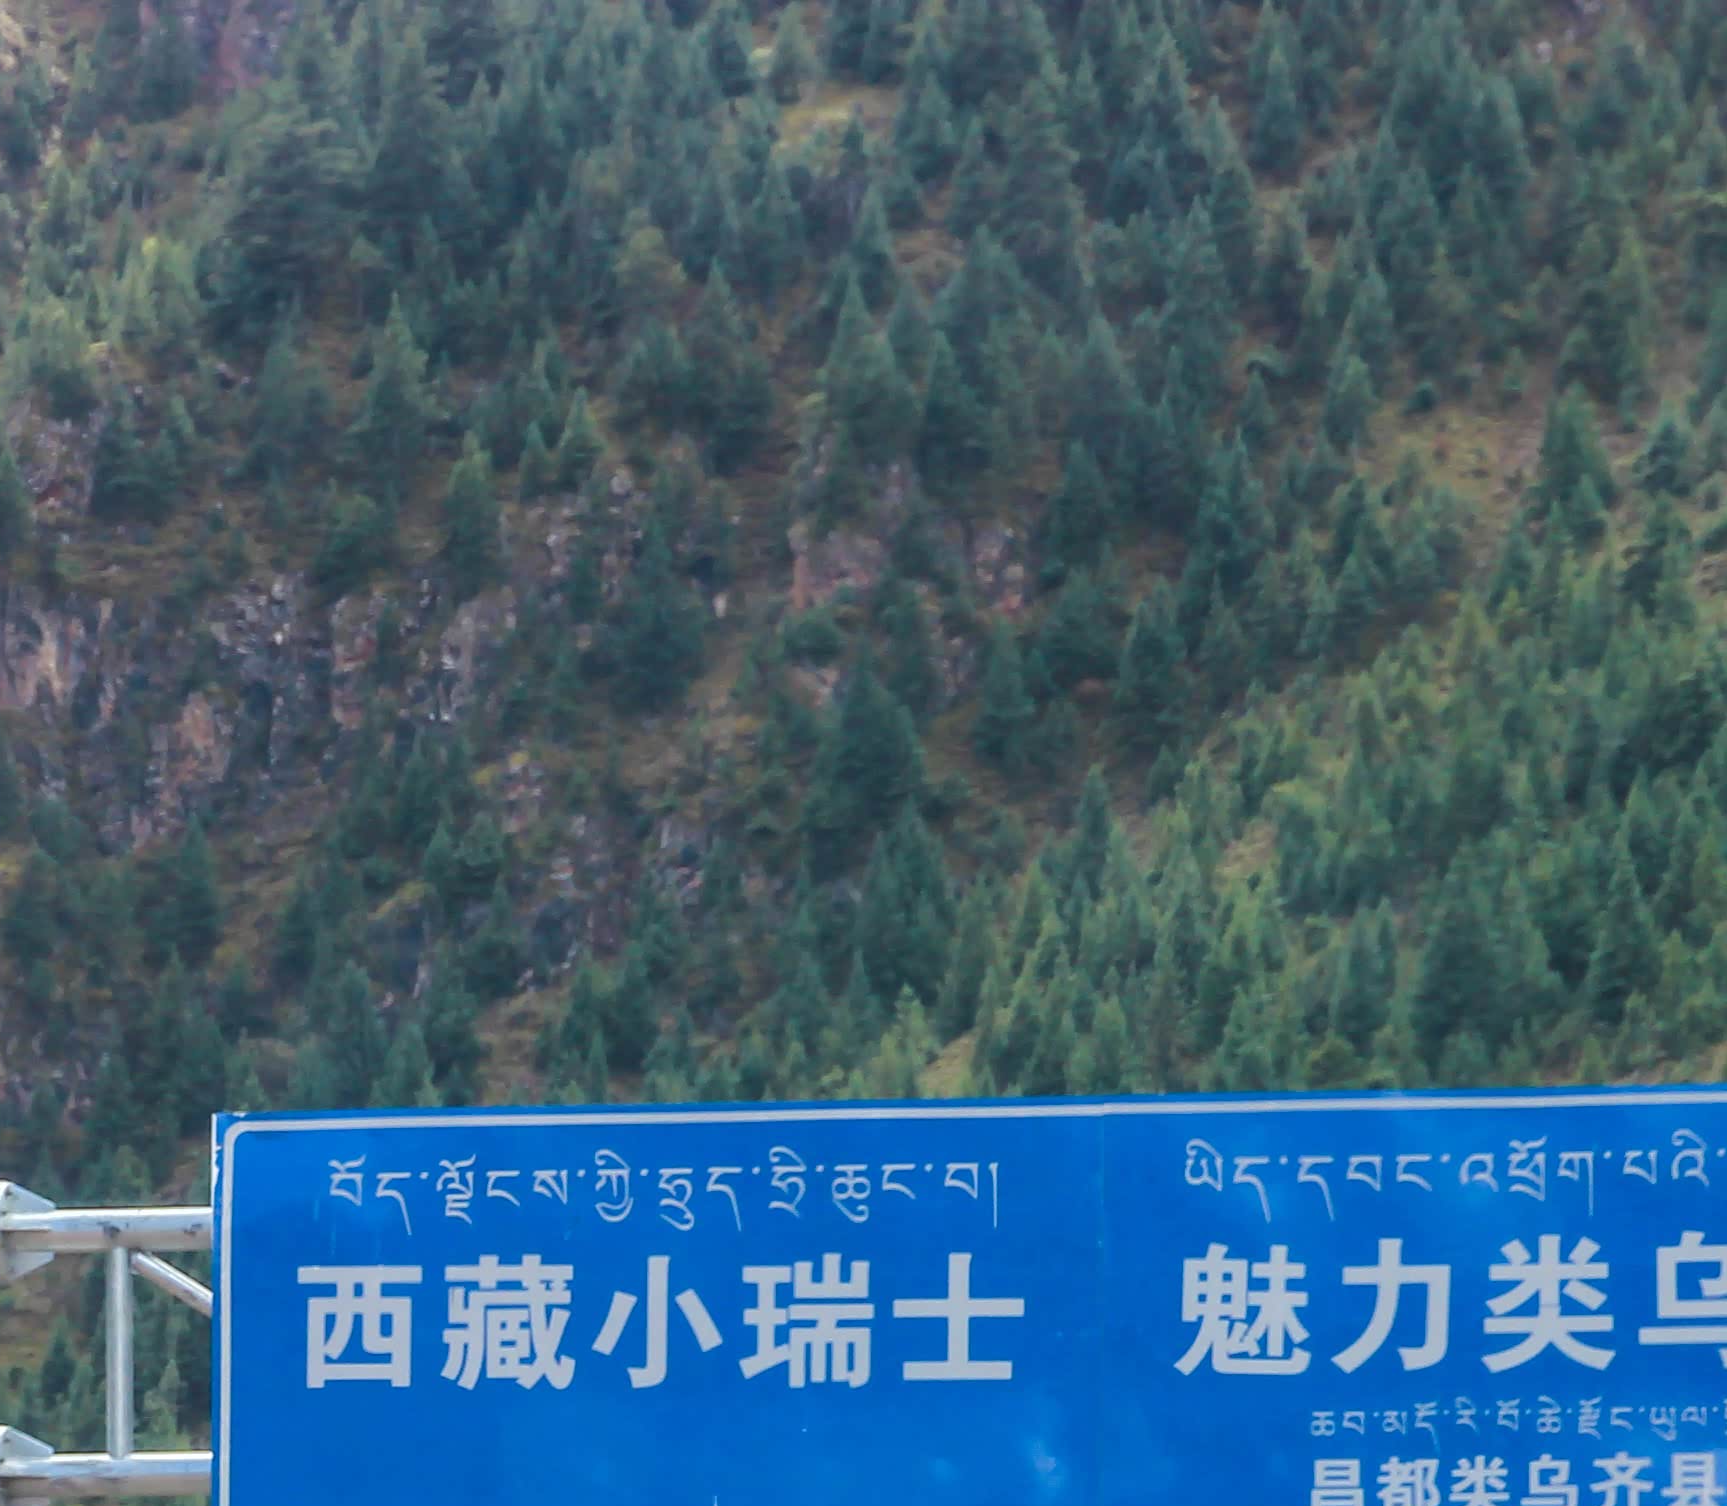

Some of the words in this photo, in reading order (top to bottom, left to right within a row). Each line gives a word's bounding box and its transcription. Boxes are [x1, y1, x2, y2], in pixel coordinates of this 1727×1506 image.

[297, 1253, 1025, 1389] 西藏小瑞士
